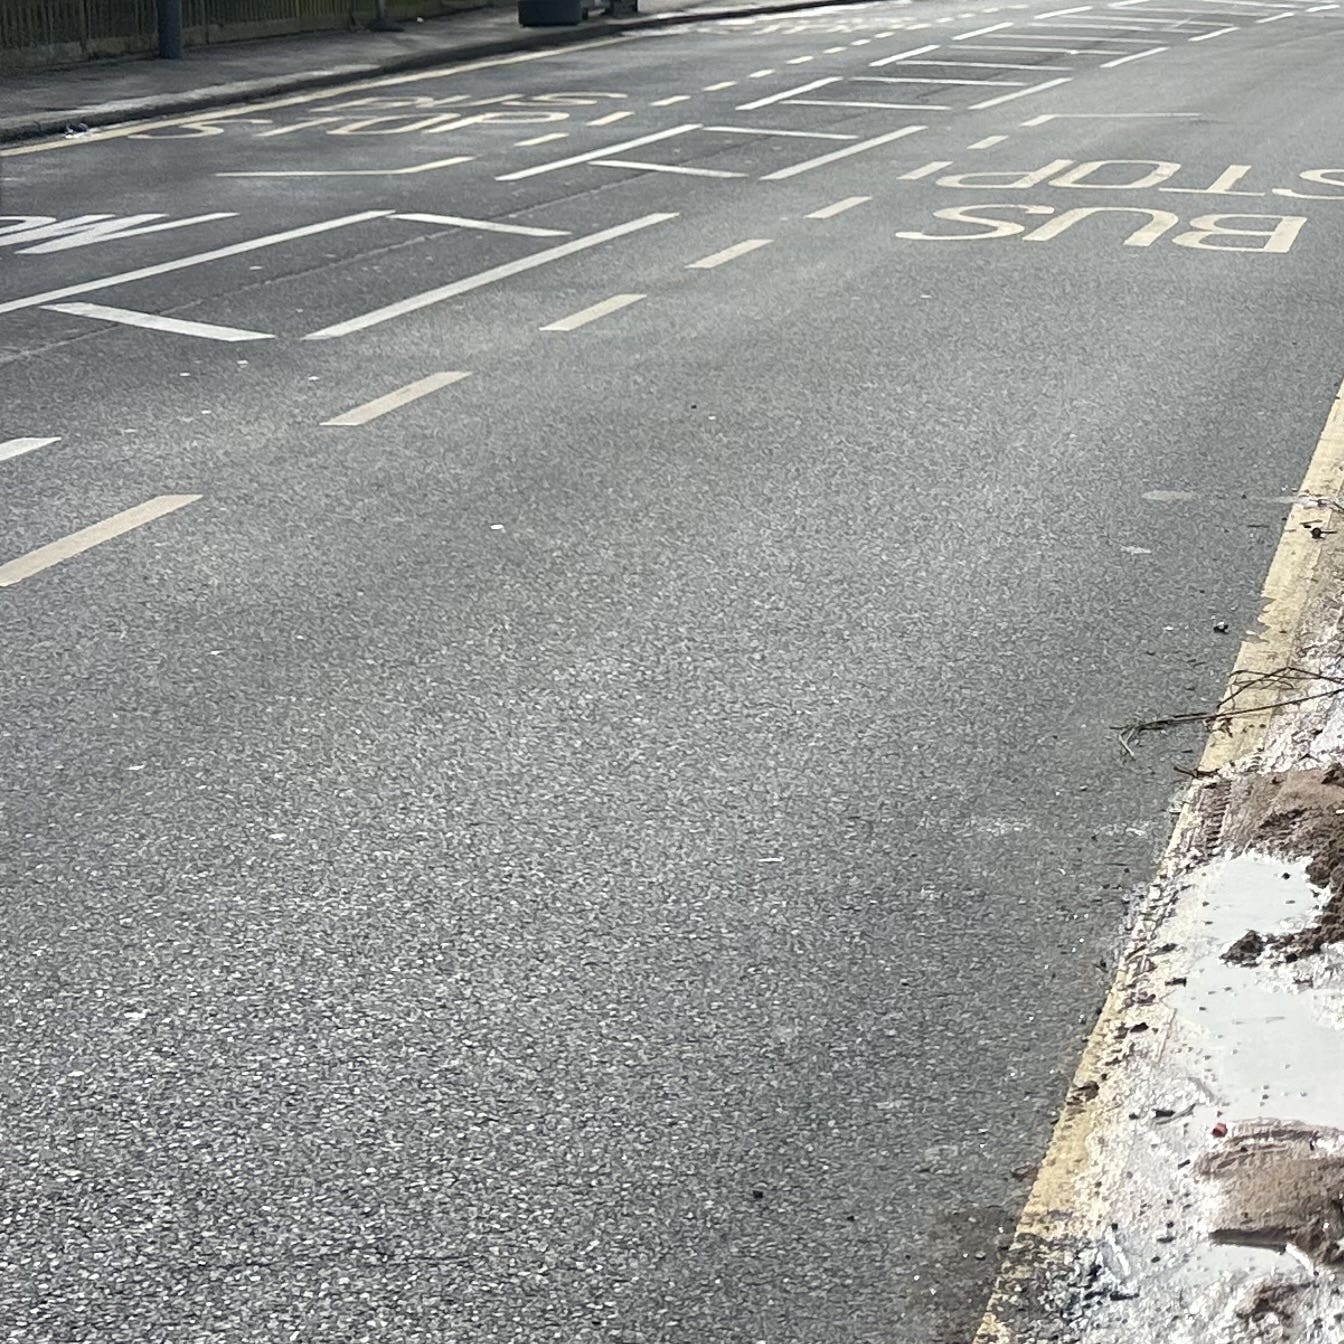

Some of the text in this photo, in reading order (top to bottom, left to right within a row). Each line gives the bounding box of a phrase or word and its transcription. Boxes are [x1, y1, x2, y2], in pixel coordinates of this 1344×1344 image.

[307, 92, 628, 112] BUS
[128, 111, 570, 139] STOP
[895, 203, 1308, 254] BUS
